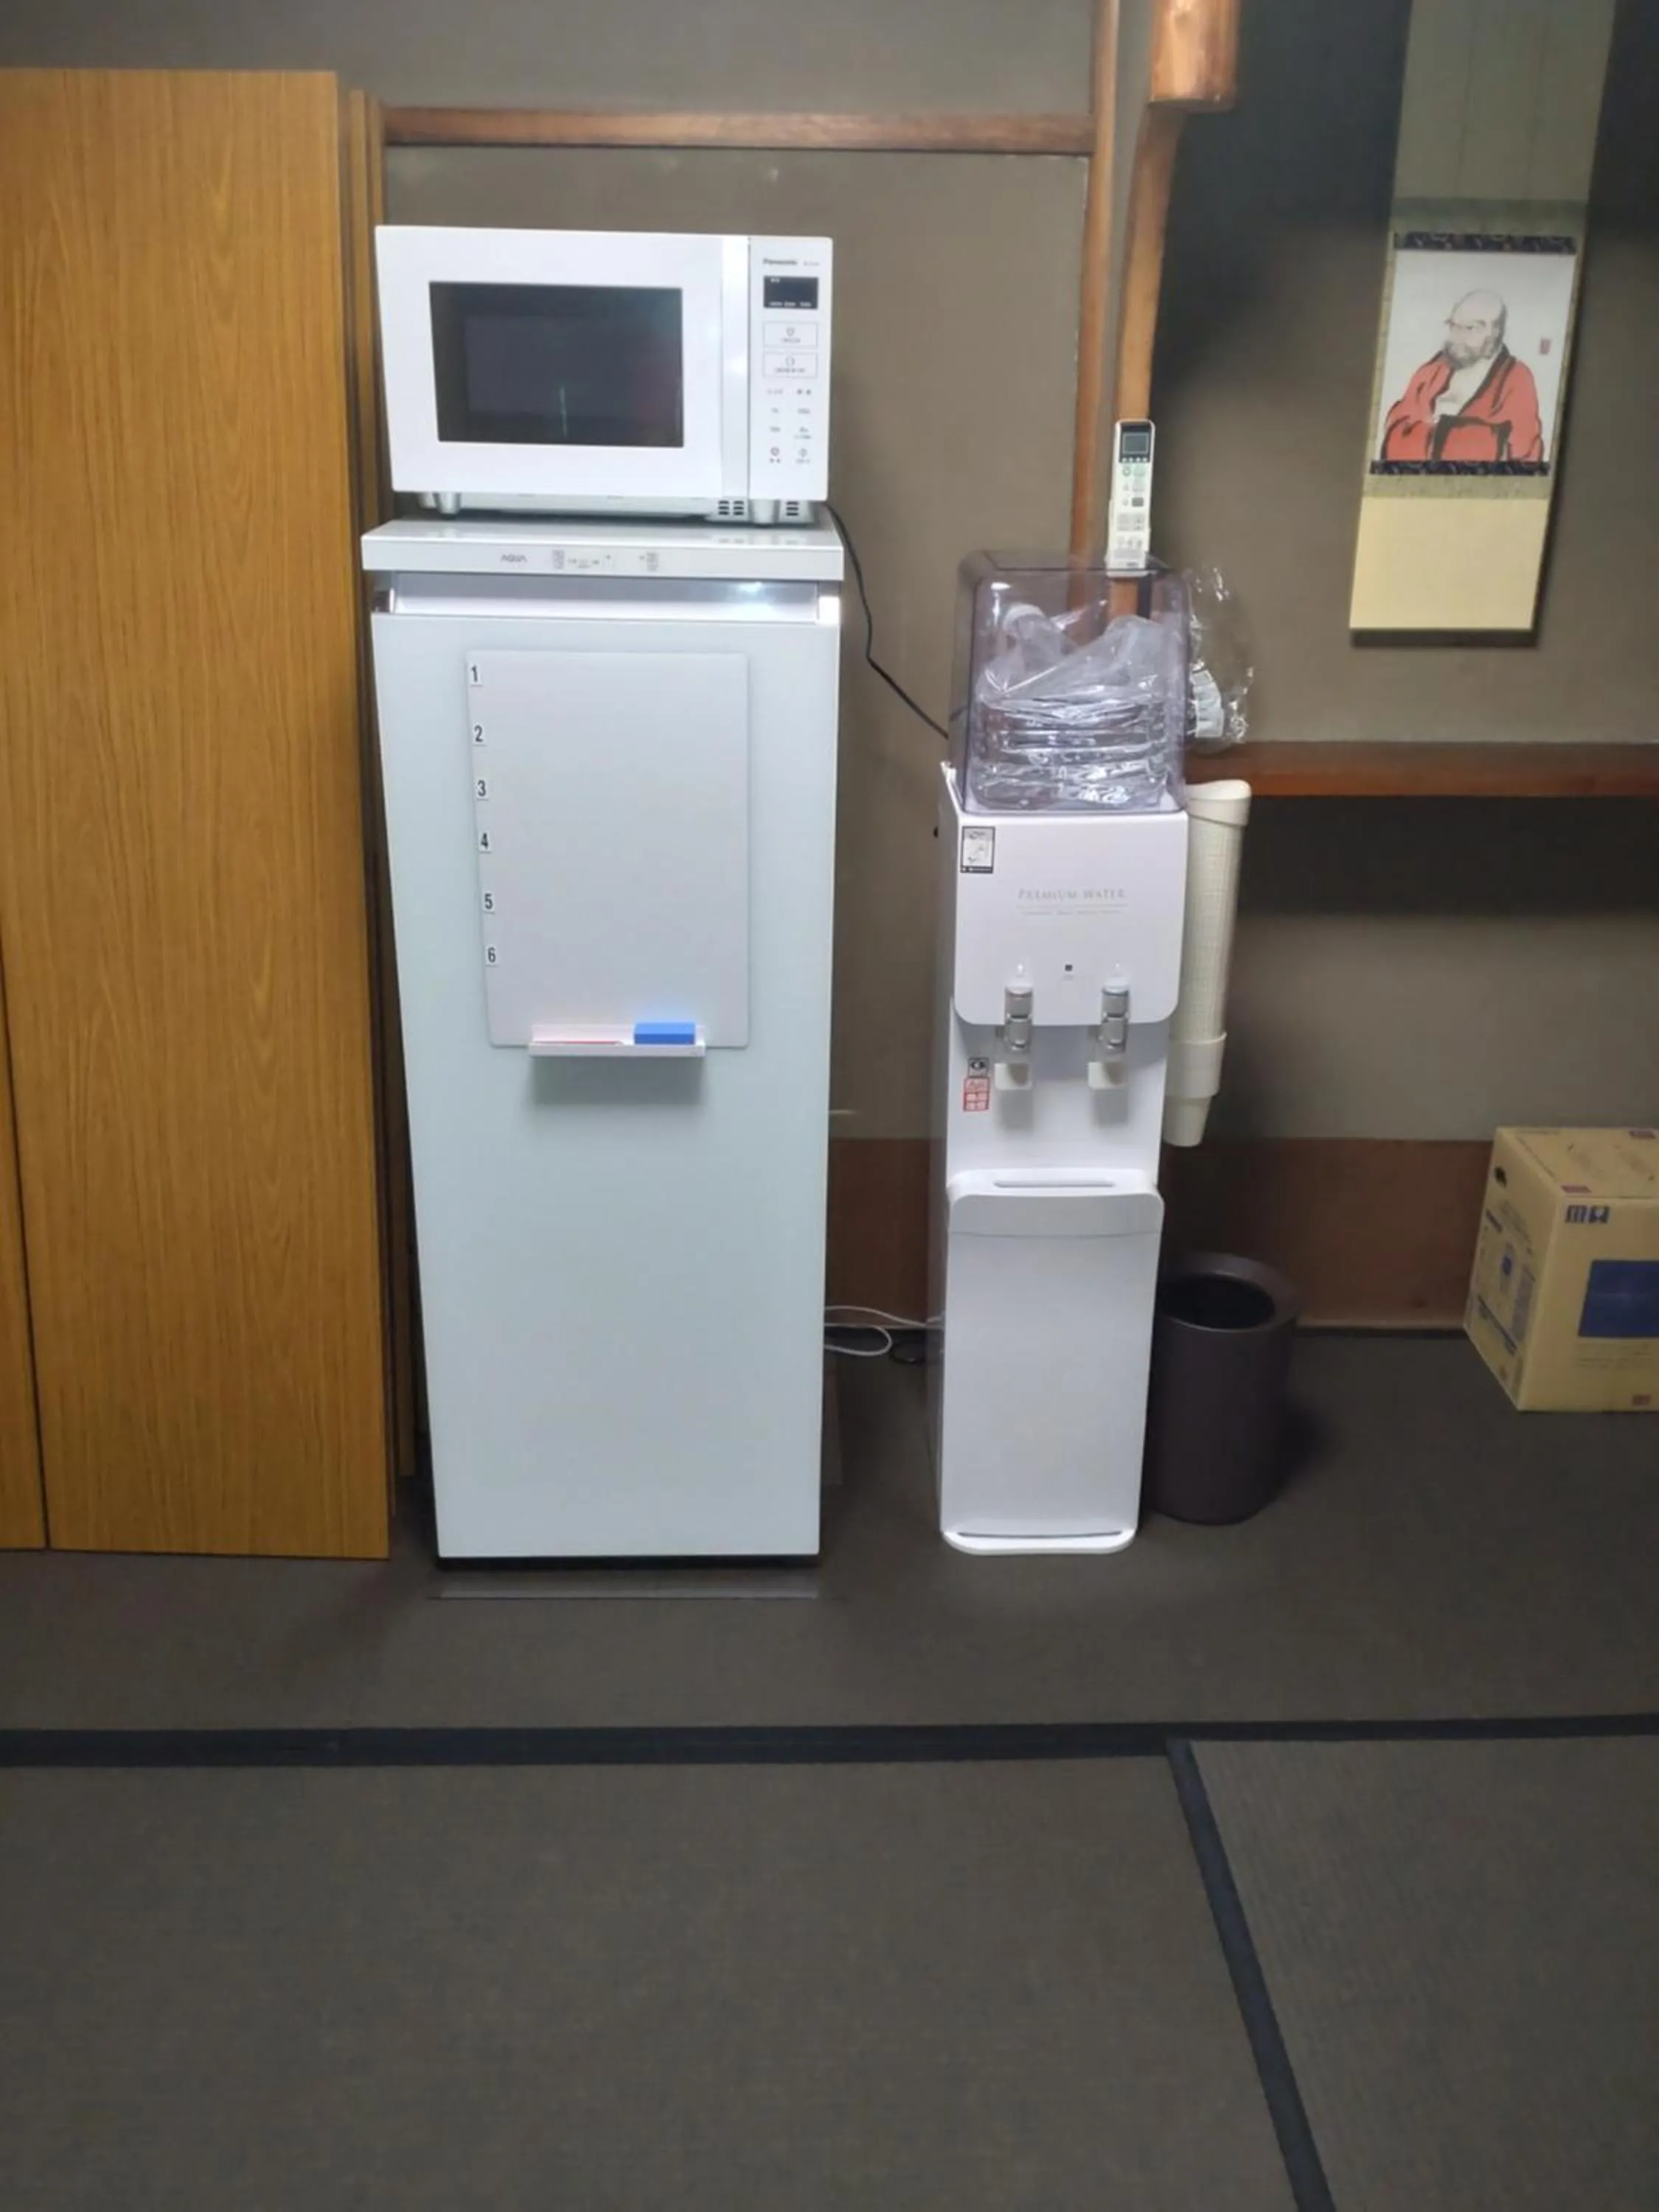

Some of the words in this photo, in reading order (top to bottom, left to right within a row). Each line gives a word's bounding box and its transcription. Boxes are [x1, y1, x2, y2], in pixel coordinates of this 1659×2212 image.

[501, 554, 528, 563] AQUA
[470, 665, 479, 682] 1
[474, 725, 483, 743] 2
[477, 779, 487, 797] 3
[480, 832, 489, 849] 4
[484, 893, 493, 910] 5
[487, 946, 496, 964] 6
